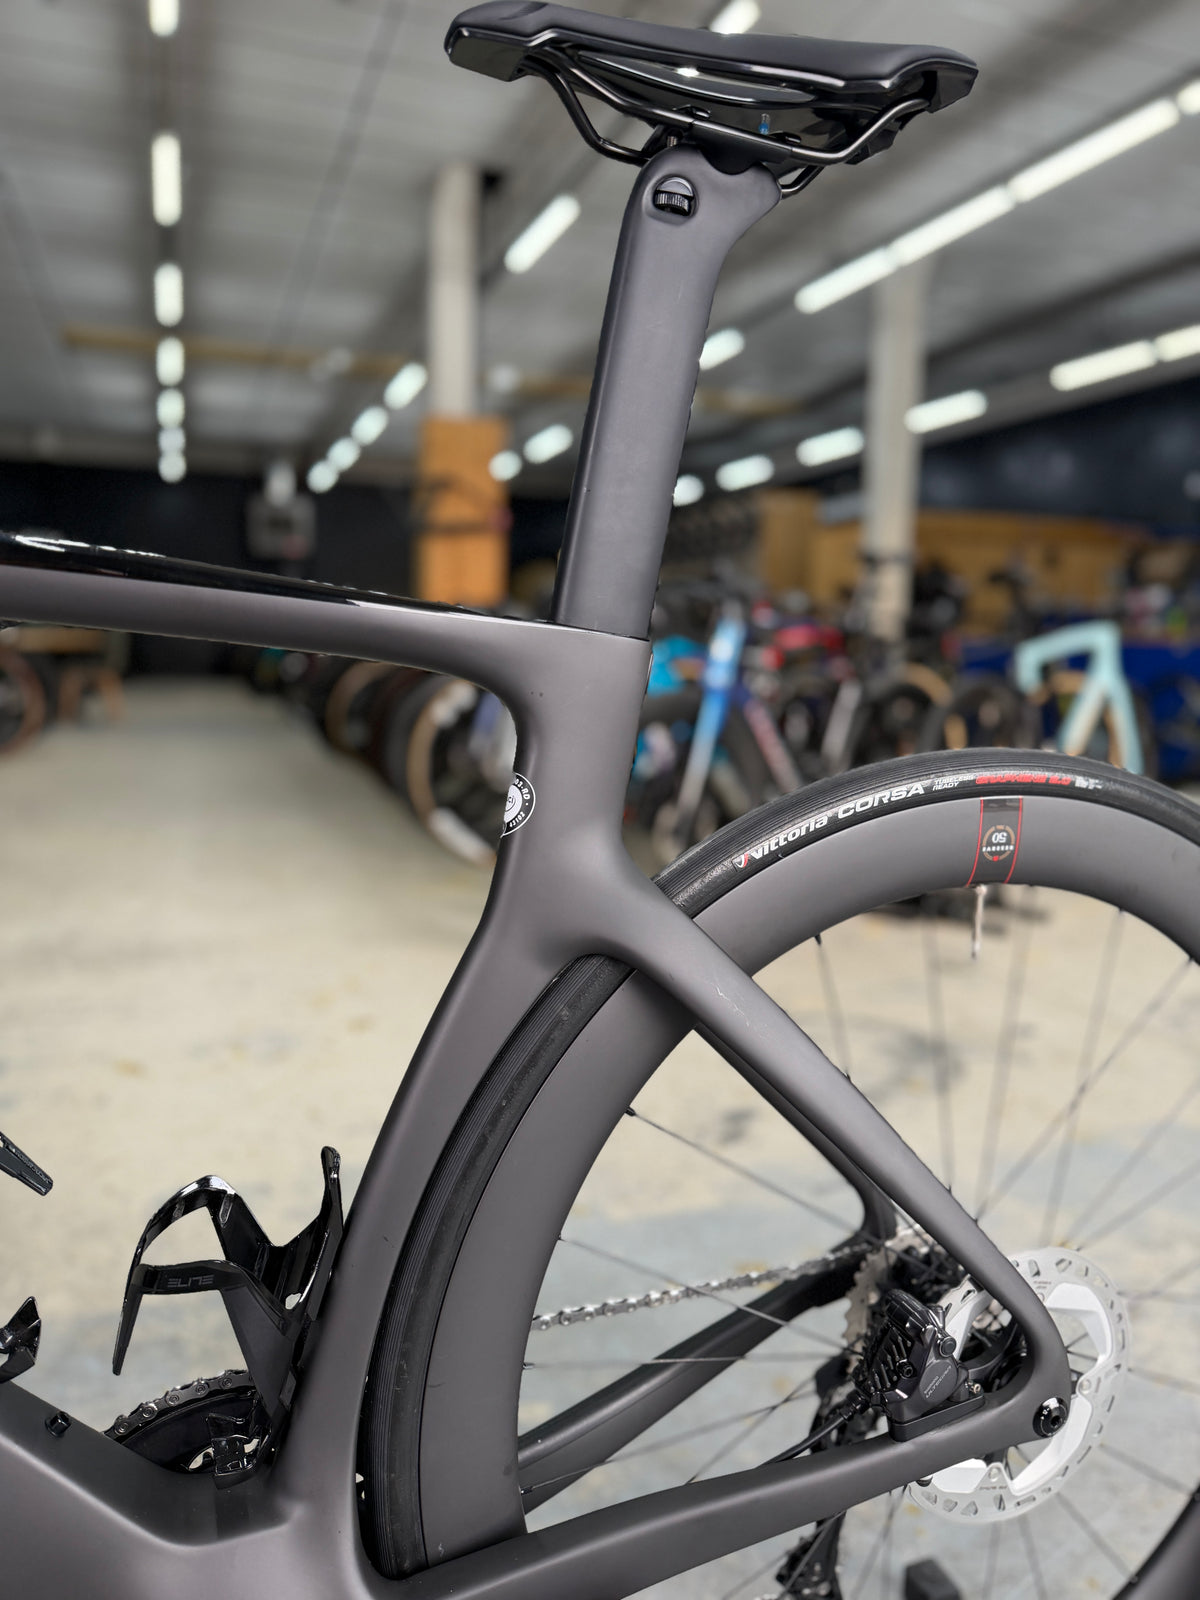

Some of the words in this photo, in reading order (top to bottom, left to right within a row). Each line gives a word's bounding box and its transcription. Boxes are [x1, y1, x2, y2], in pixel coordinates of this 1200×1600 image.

[932, 782, 960, 791] READY
[750, 815, 829, 860] Vittoria
[837, 783, 925, 819] CORSA
[991, 831, 1008, 844] 50
[167, 1274, 215, 1288] ELITE
